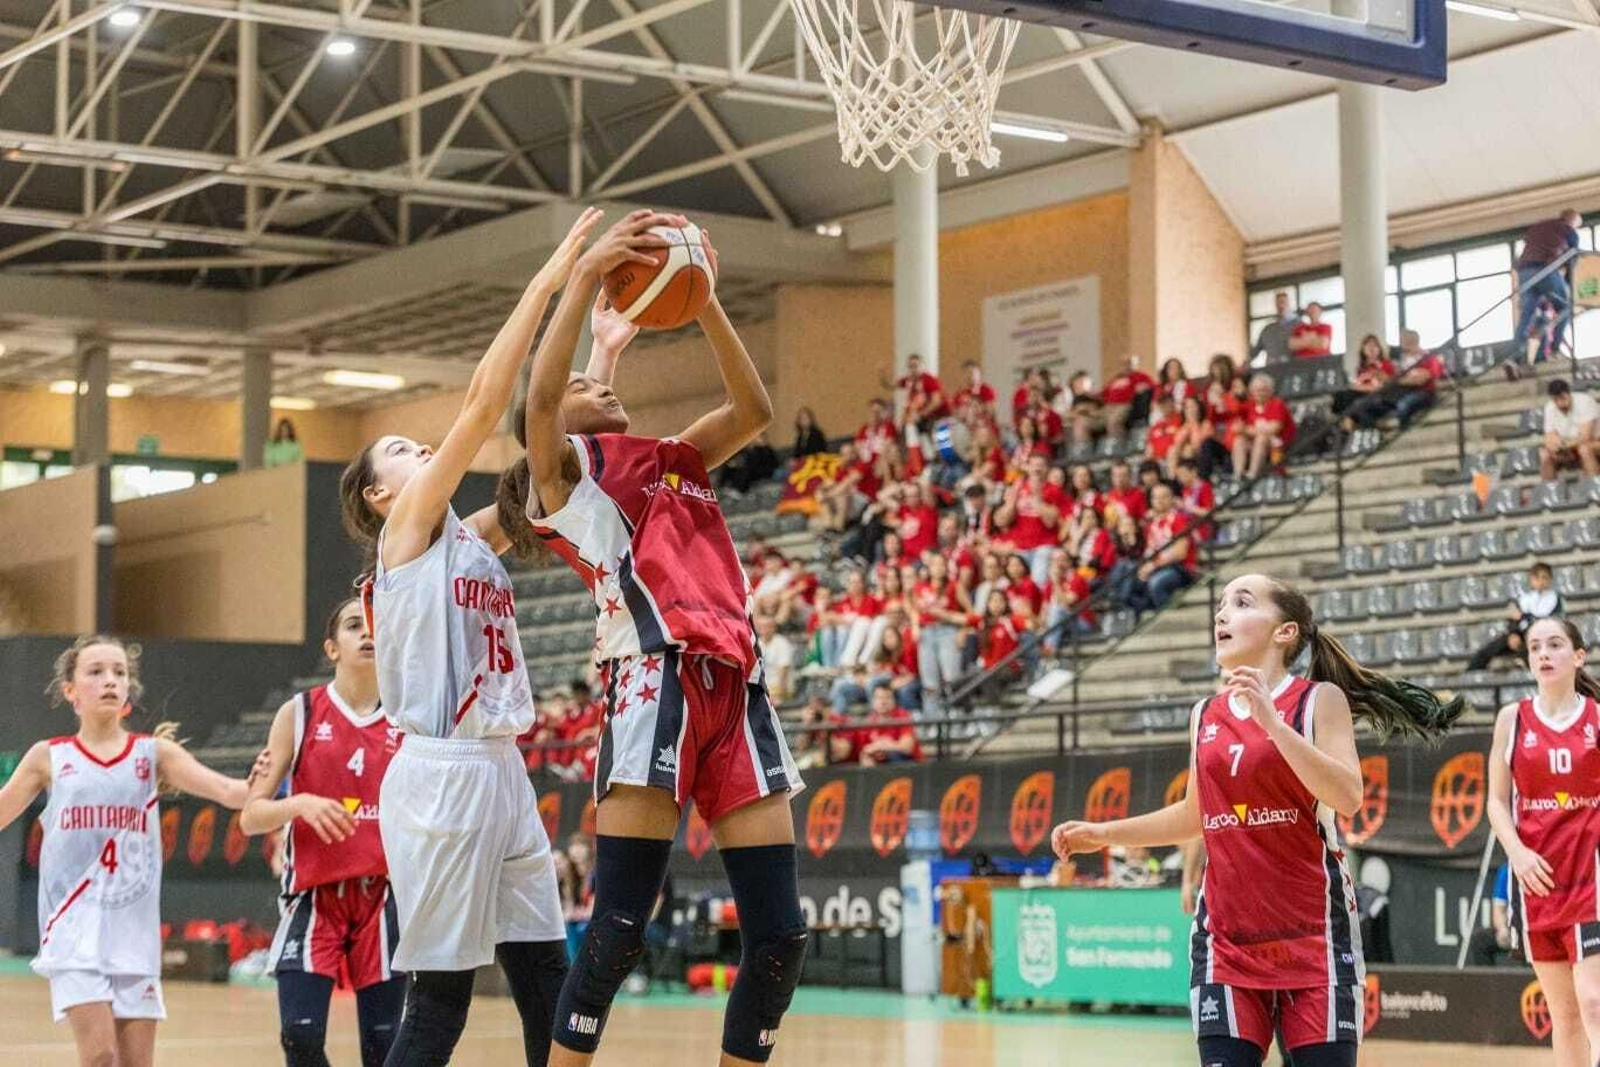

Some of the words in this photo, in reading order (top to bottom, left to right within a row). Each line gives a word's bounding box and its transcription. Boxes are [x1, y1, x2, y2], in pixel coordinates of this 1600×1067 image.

[483, 624, 514, 674] 15
[346, 747, 365, 777] 4
[1228, 743, 1245, 777] 7
[1548, 747, 1572, 774] 10
[1248, 807, 1299, 826] Aldany
[99, 837, 119, 875] 4
[823, 884, 872, 938] de
[878, 886, 900, 938] S
[577, 1014, 599, 1035] NBA
